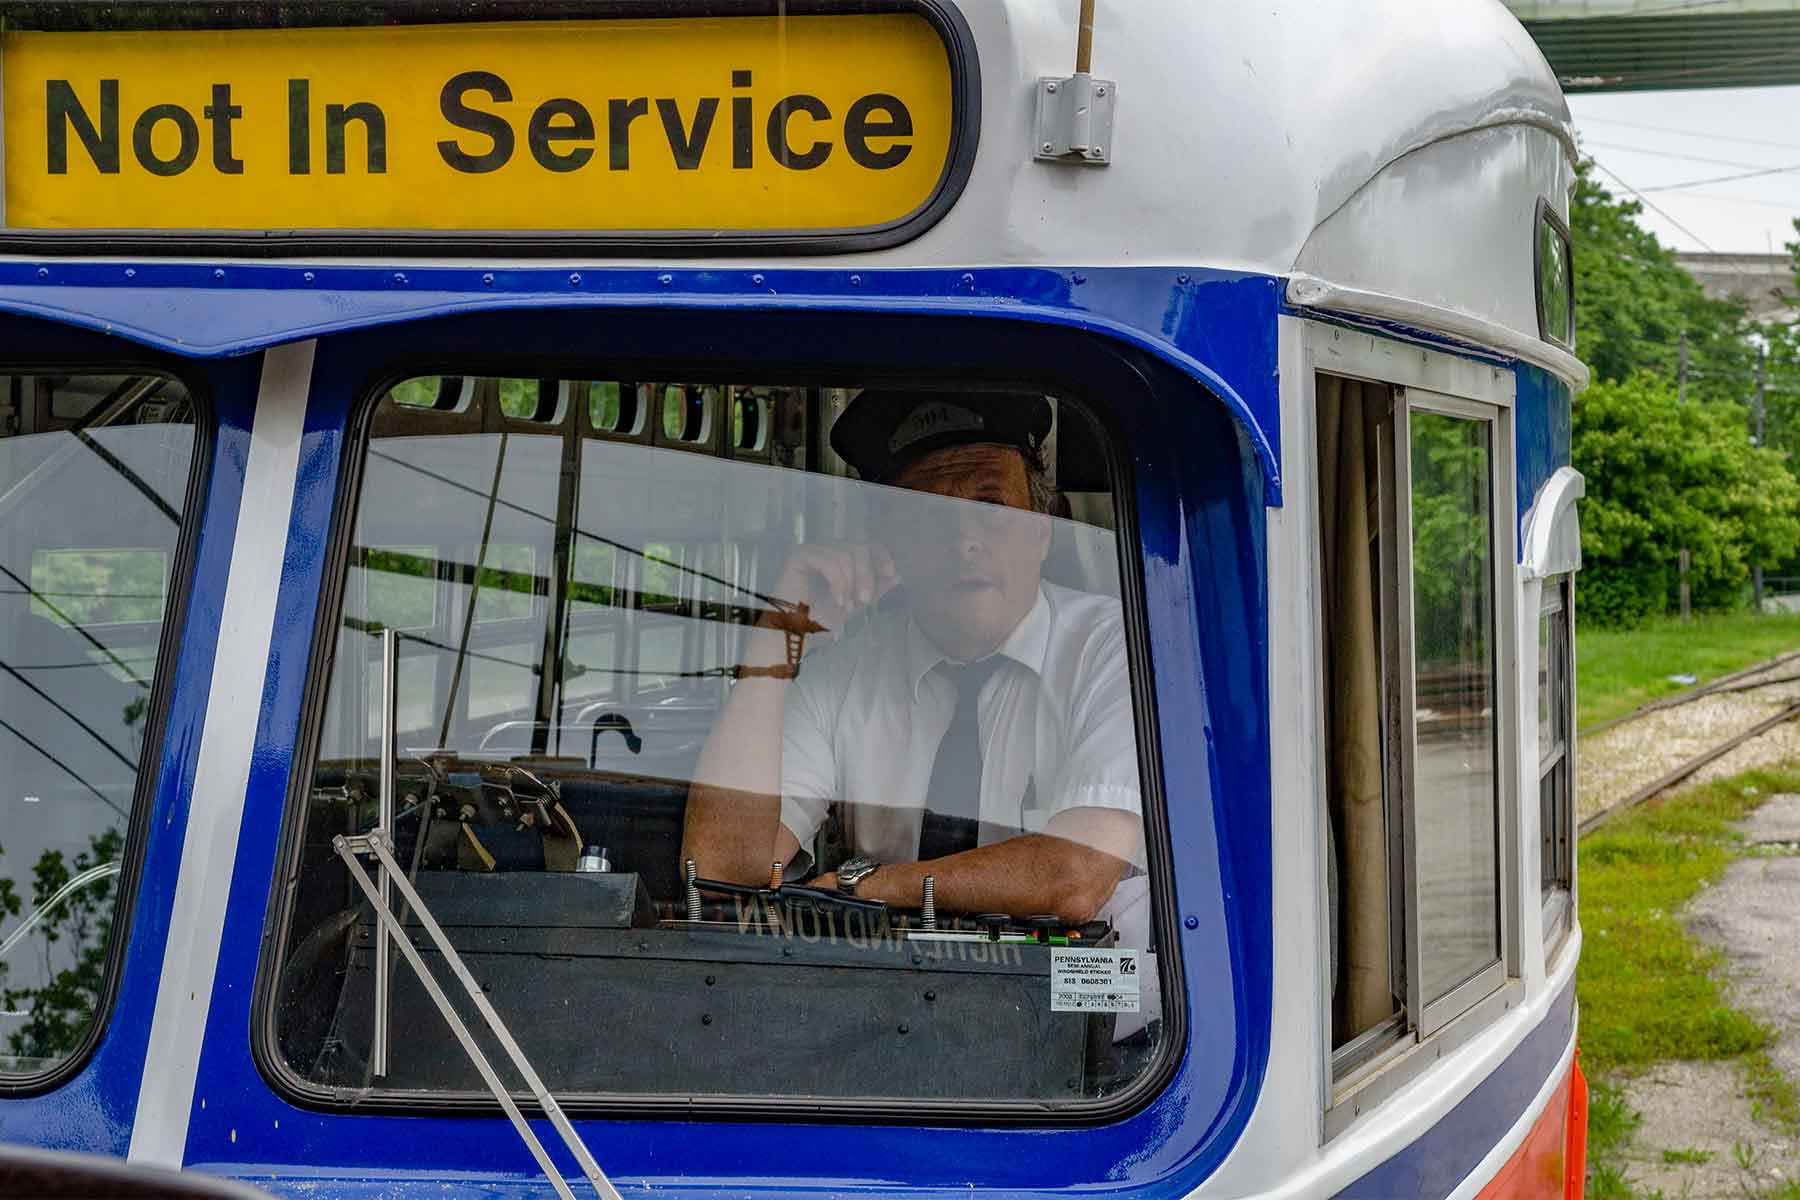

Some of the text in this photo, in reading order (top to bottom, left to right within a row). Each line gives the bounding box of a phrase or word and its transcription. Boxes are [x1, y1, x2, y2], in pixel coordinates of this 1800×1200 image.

[45, 70, 913, 175] Not In Service
